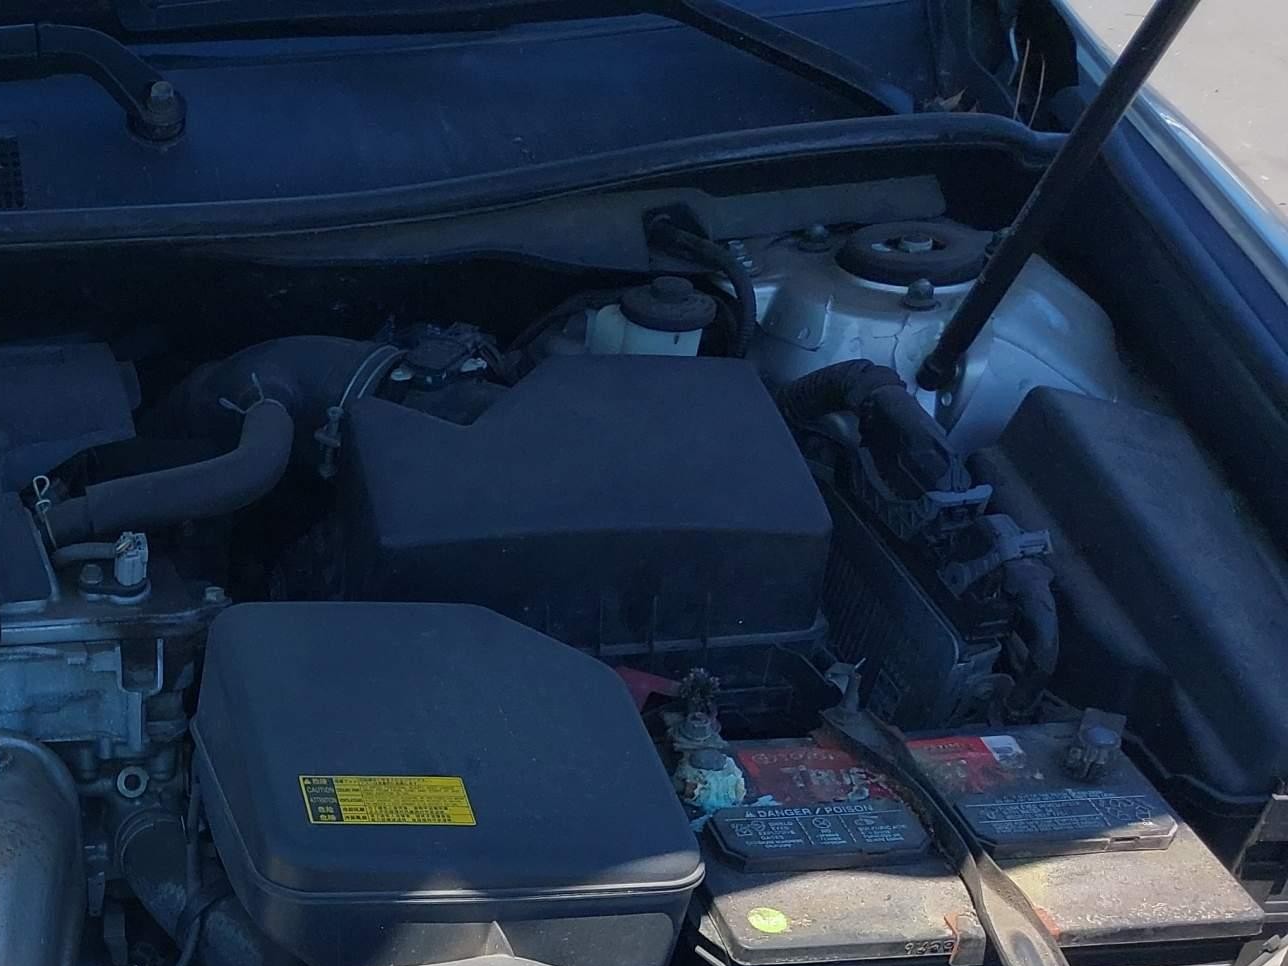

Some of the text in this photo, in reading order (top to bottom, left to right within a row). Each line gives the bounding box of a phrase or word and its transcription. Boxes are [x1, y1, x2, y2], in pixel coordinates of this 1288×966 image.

[757, 804, 873, 818] DANGER / POISON
